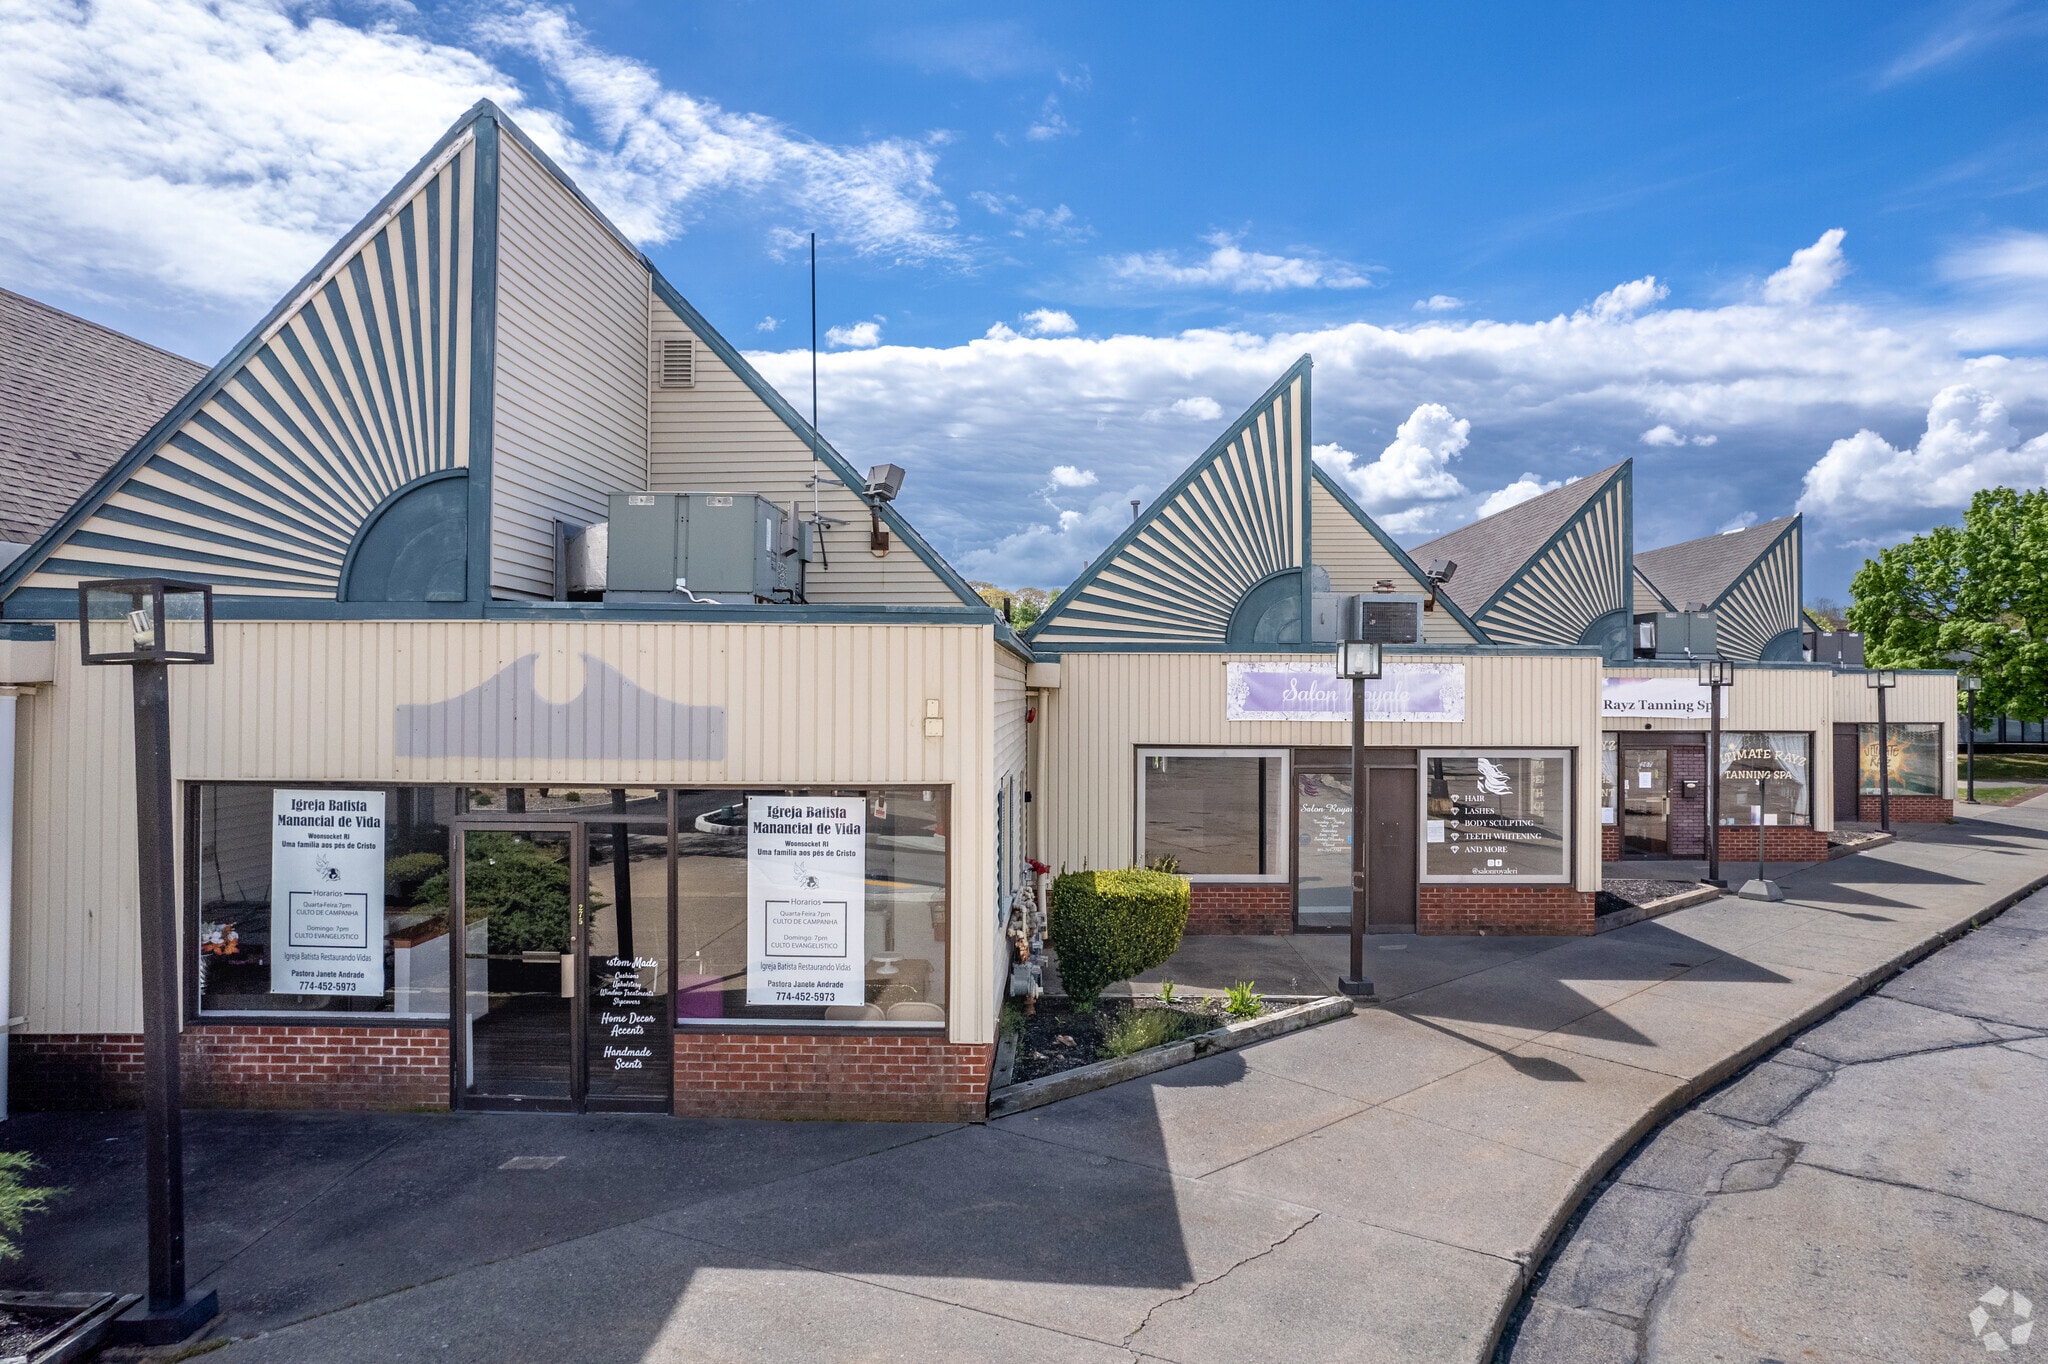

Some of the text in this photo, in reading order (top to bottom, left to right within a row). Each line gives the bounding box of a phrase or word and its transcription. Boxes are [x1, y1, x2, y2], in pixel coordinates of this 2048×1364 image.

[1282, 677, 1410, 711] Salon oyale
[1604, 700, 1712, 712] Rayz Tanning Sp
[1720, 749, 1806, 767] LTIMATE RAYZ
[1725, 771, 1792, 780] TANNING SPA
[291, 799, 367, 812] Igreja Batista
[1300, 804, 1324, 812] Salon
[768, 806, 846, 819] Igreja Batista
[278, 815, 380, 828] Manancial de Vida
[753, 822, 861, 835] Manancial de Vida
[334, 842, 345, 850] pés
[812, 849, 824, 858] pés
[284, 952, 300, 961] Igreja
[301, 952, 320, 961] Batista
[632, 957, 658, 968] Made
[760, 962, 851, 971] Igreja Batista Restaurando Vidas
[614, 972, 639, 980] Cushions
[299, 982, 356, 992] 774-452-5973
[612, 980, 642, 990] Upholstery
[768, 980, 844, 989] Pastora Janete Andrade
[624, 989, 654, 997] Treatments
[776, 992, 835, 1002] 774-452-5973
[601, 1012, 656, 1024] Home Decor
[610, 1024, 644, 1037] Accents
[603, 1046, 652, 1058] Handmade
[614, 1058, 642, 1070] Scents
